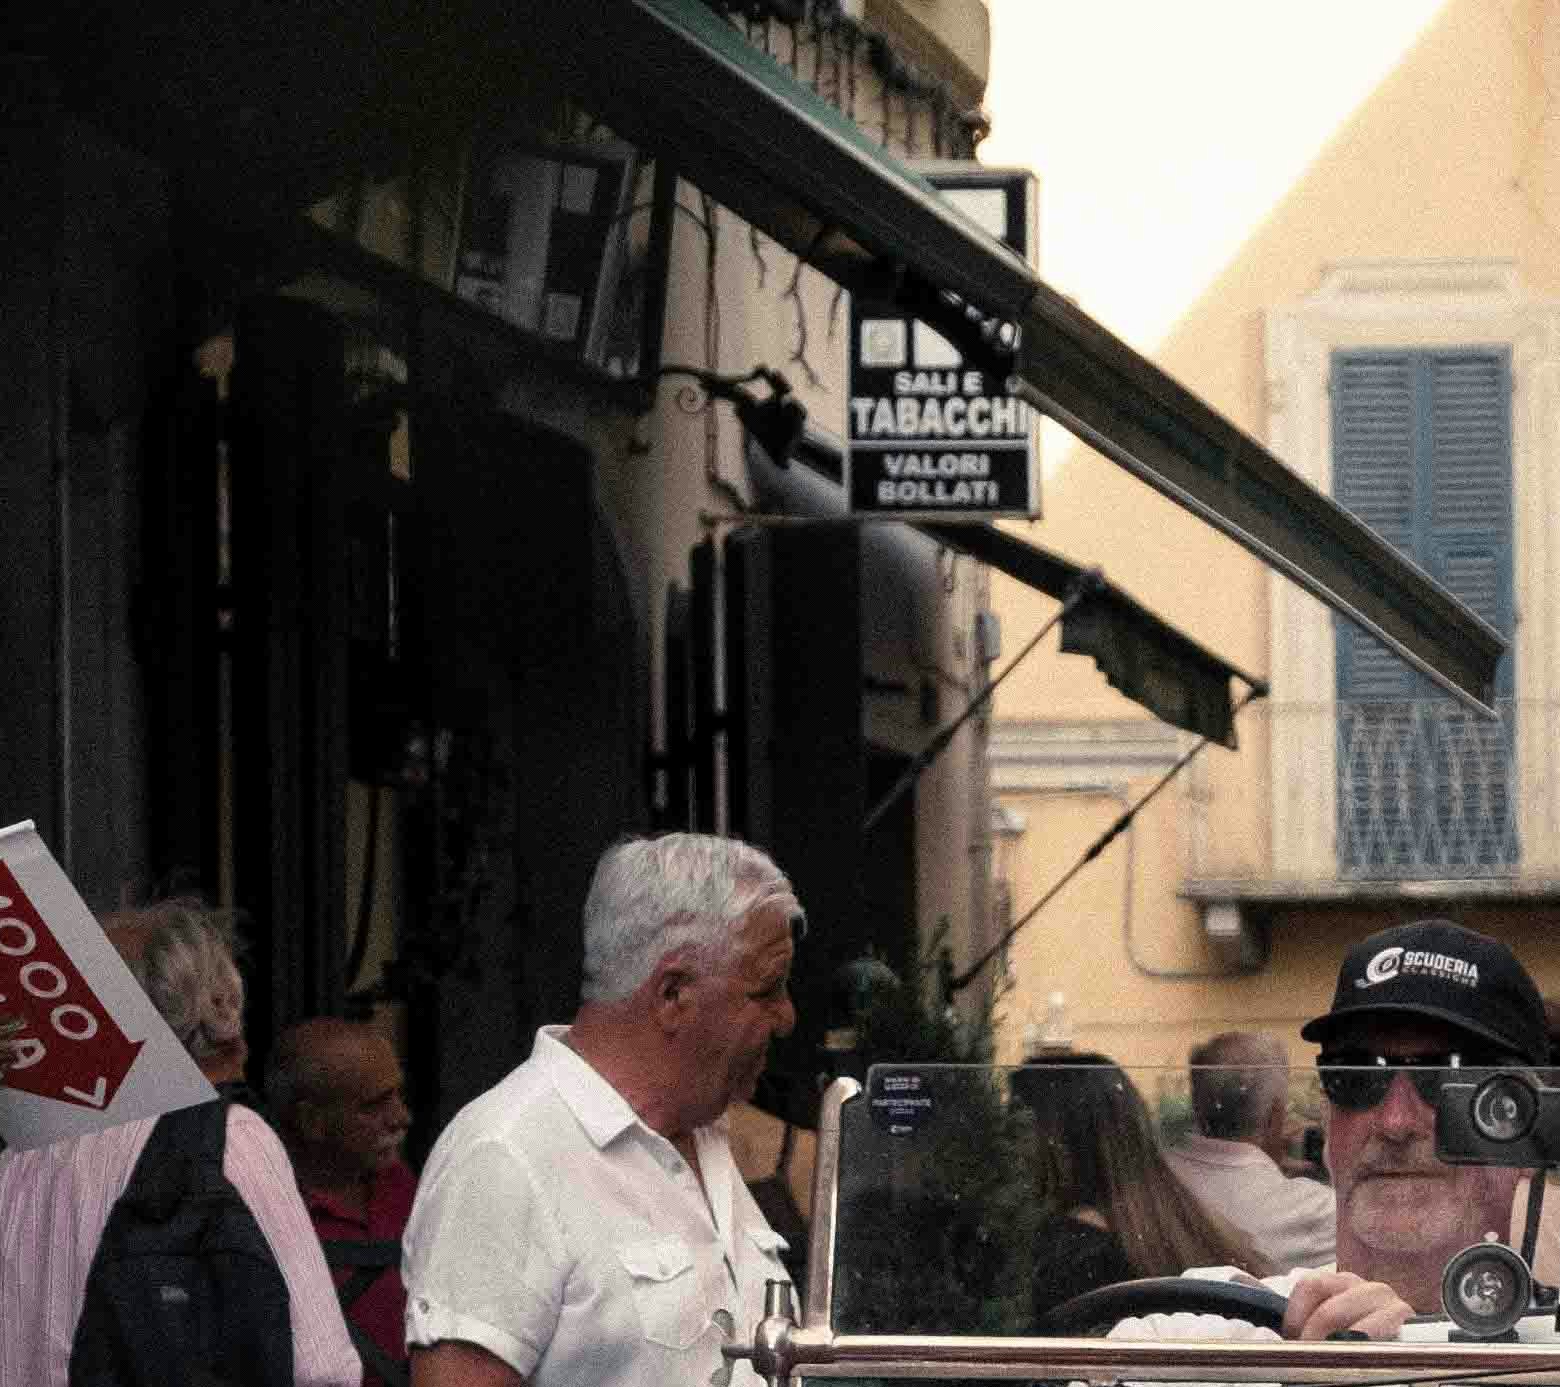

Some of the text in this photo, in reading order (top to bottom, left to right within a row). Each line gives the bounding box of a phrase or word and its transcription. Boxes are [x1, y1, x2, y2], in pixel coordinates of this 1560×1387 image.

[963, 371, 984, 396] E
[852, 398, 1029, 435] TABACCHI
[885, 453, 991, 478] VALORI
[877, 479, 1000, 504] BOLLATI
[1403, 951, 1480, 979] SCUDERIA
